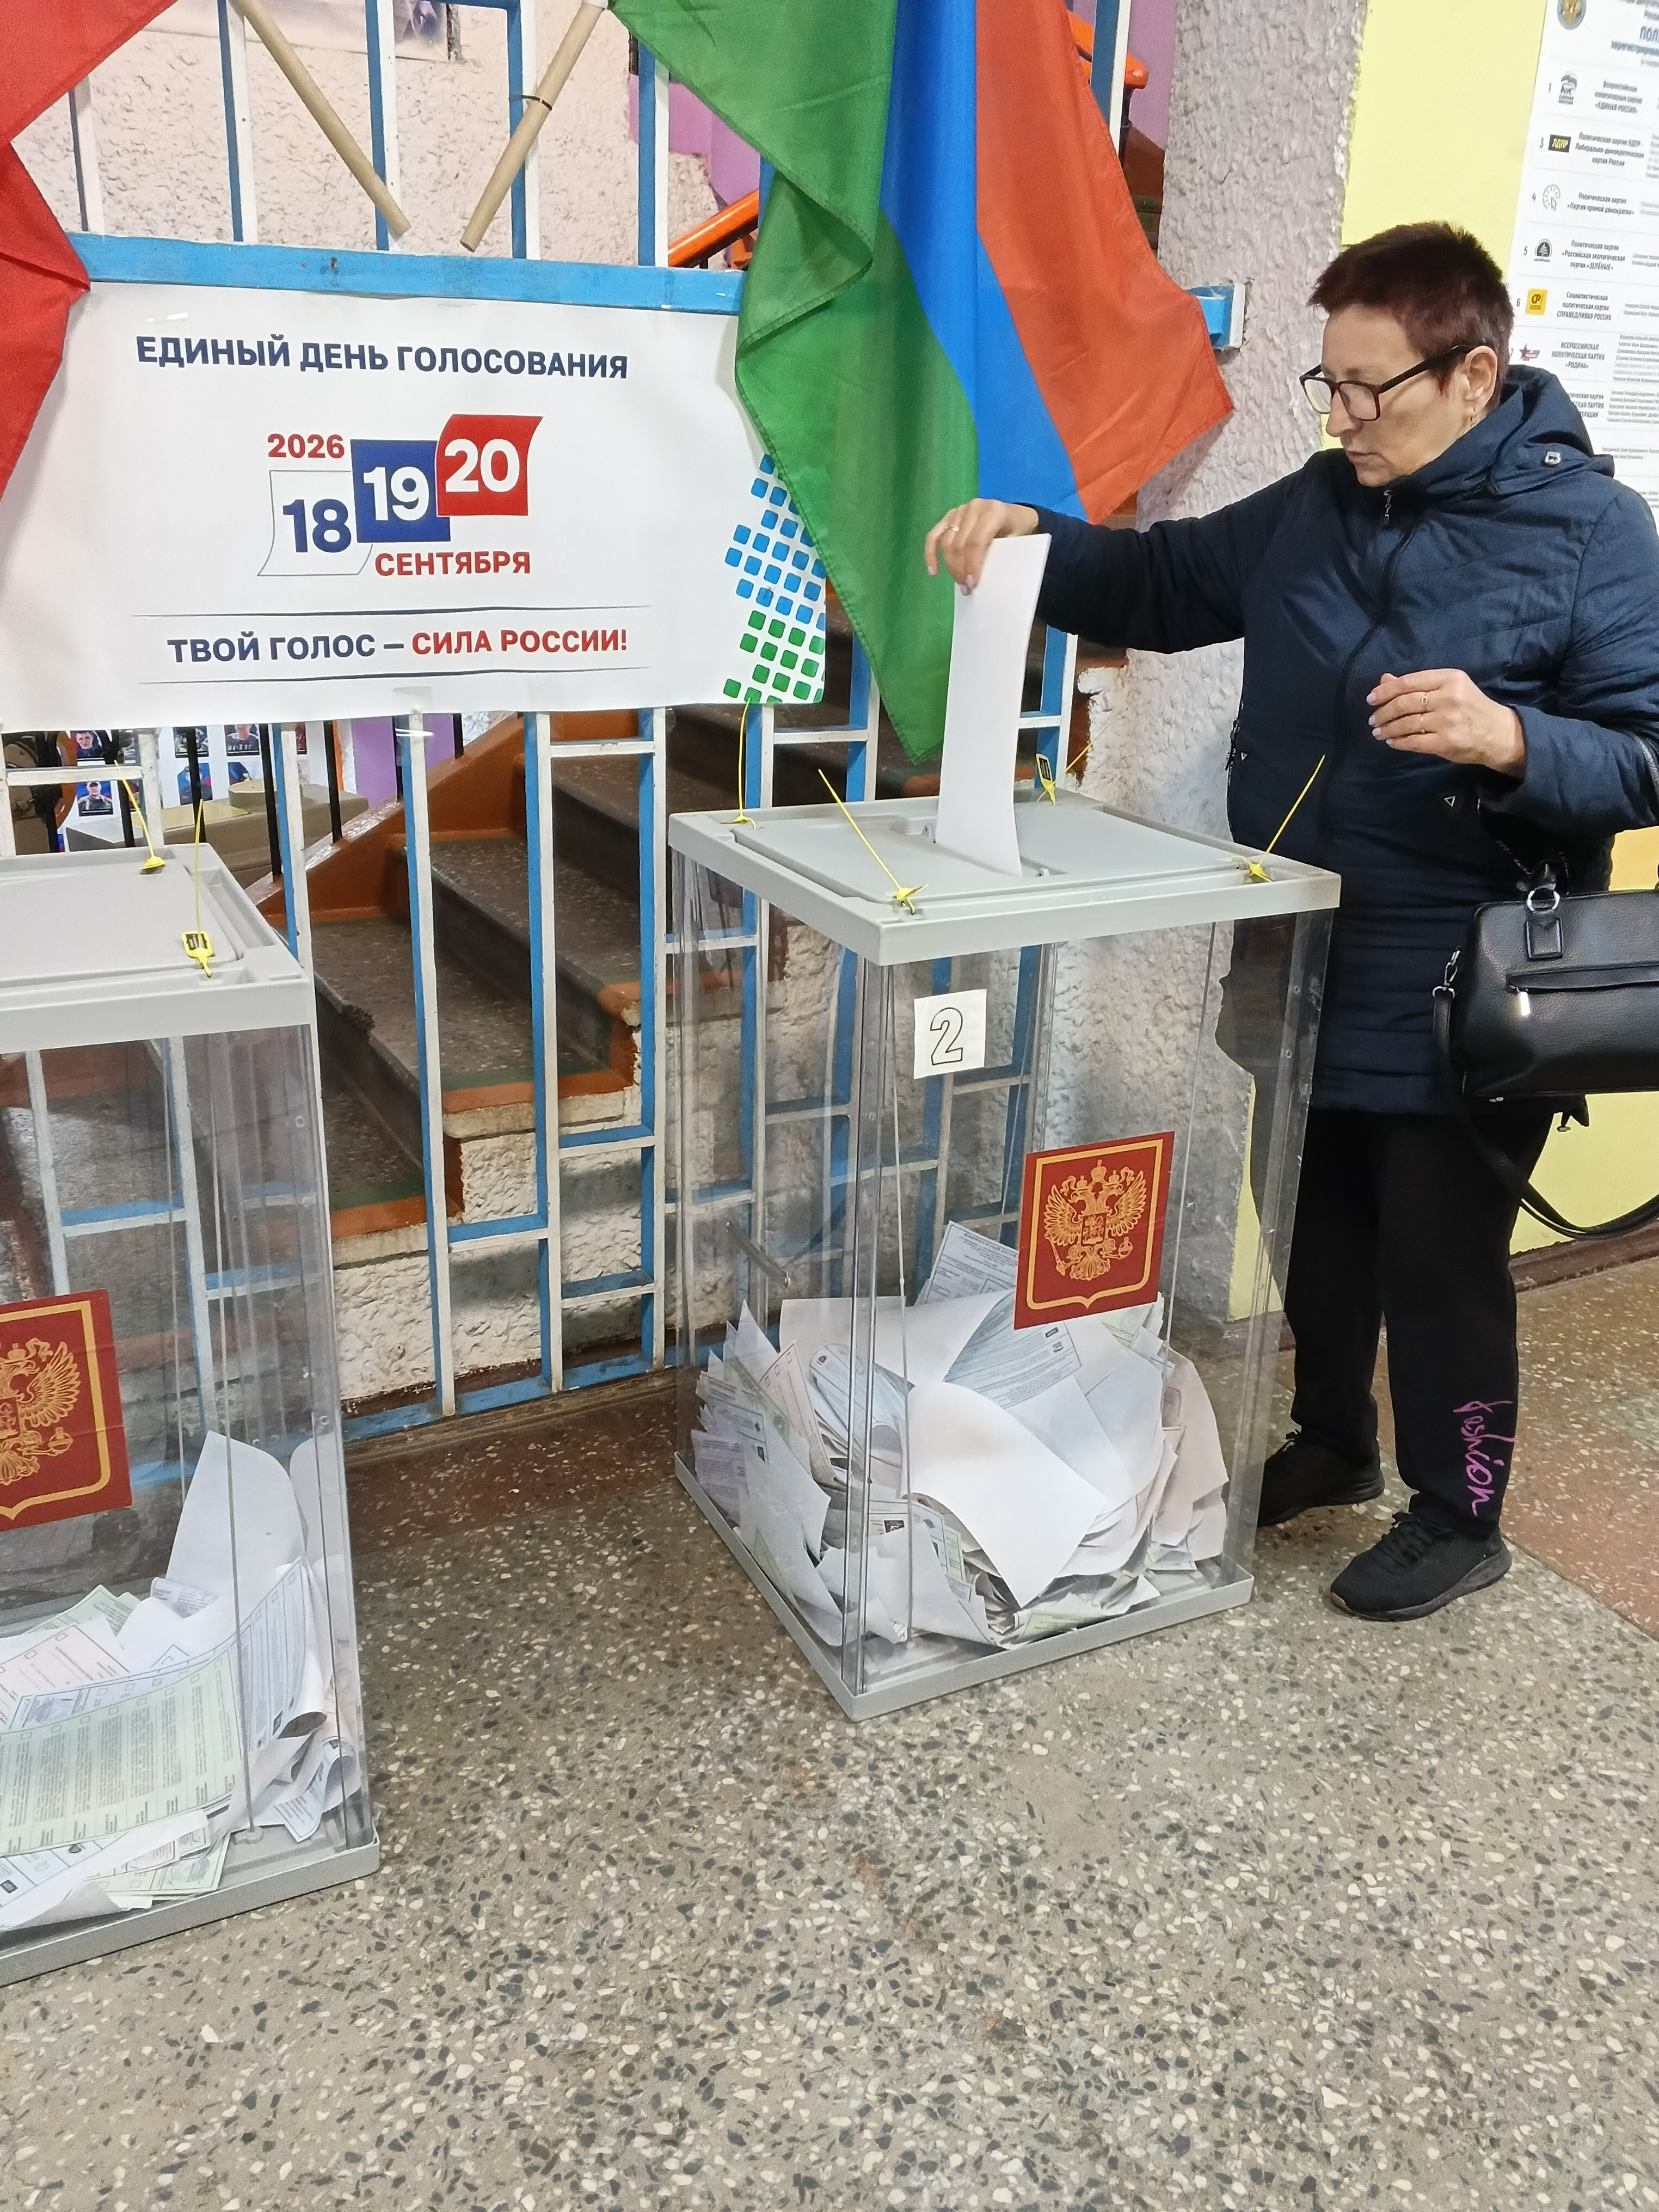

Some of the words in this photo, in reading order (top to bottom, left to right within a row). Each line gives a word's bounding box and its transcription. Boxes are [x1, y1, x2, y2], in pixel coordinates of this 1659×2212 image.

[1639, 26, 1659, 44] ПОЛ
[1539, 137, 1544, 148] 3
[1552, 138, 1569, 150] ЛДПР
[1532, 192, 1536, 201] 4
[1578, 192, 1611, 202] Политическая
[1571, 240, 1603, 249] Политическая
[1523, 246, 1528, 256] 5
[1566, 291, 1608, 301] Социалистическая
[1516, 298, 1521, 307] 6
[1557, 311, 1593, 319] СПРАВЕДЛИВАЯ
[1560, 341, 1600, 350] ВСЕРОССИЙСКАЯ
[137, 333, 290, 368] ЕДИНЫЙ
[300, 342, 388, 372] ДЕНЬ
[397, 346, 628, 379] ГОЛОСОВАНИЯ
[1551, 351, 1587, 359] ПОЛИТИЧЕСКАЯ
[1588, 352, 1605, 360] ПАРТИЯ
[267, 433, 345, 459] 2026
[282, 499, 352, 553] 18
[363, 466, 429, 521] 19
[444, 439, 520, 493] 20
[374, 551, 531, 577] СЕНТЯБРЯ
[167, 630, 260, 662] ТВОЙ
[269, 634, 376, 660] ГОЛОС
[411, 630, 493, 655] СИЛА
[500, 629, 627, 653] РОССИИ!
[930, 1007, 963, 1066] 2
